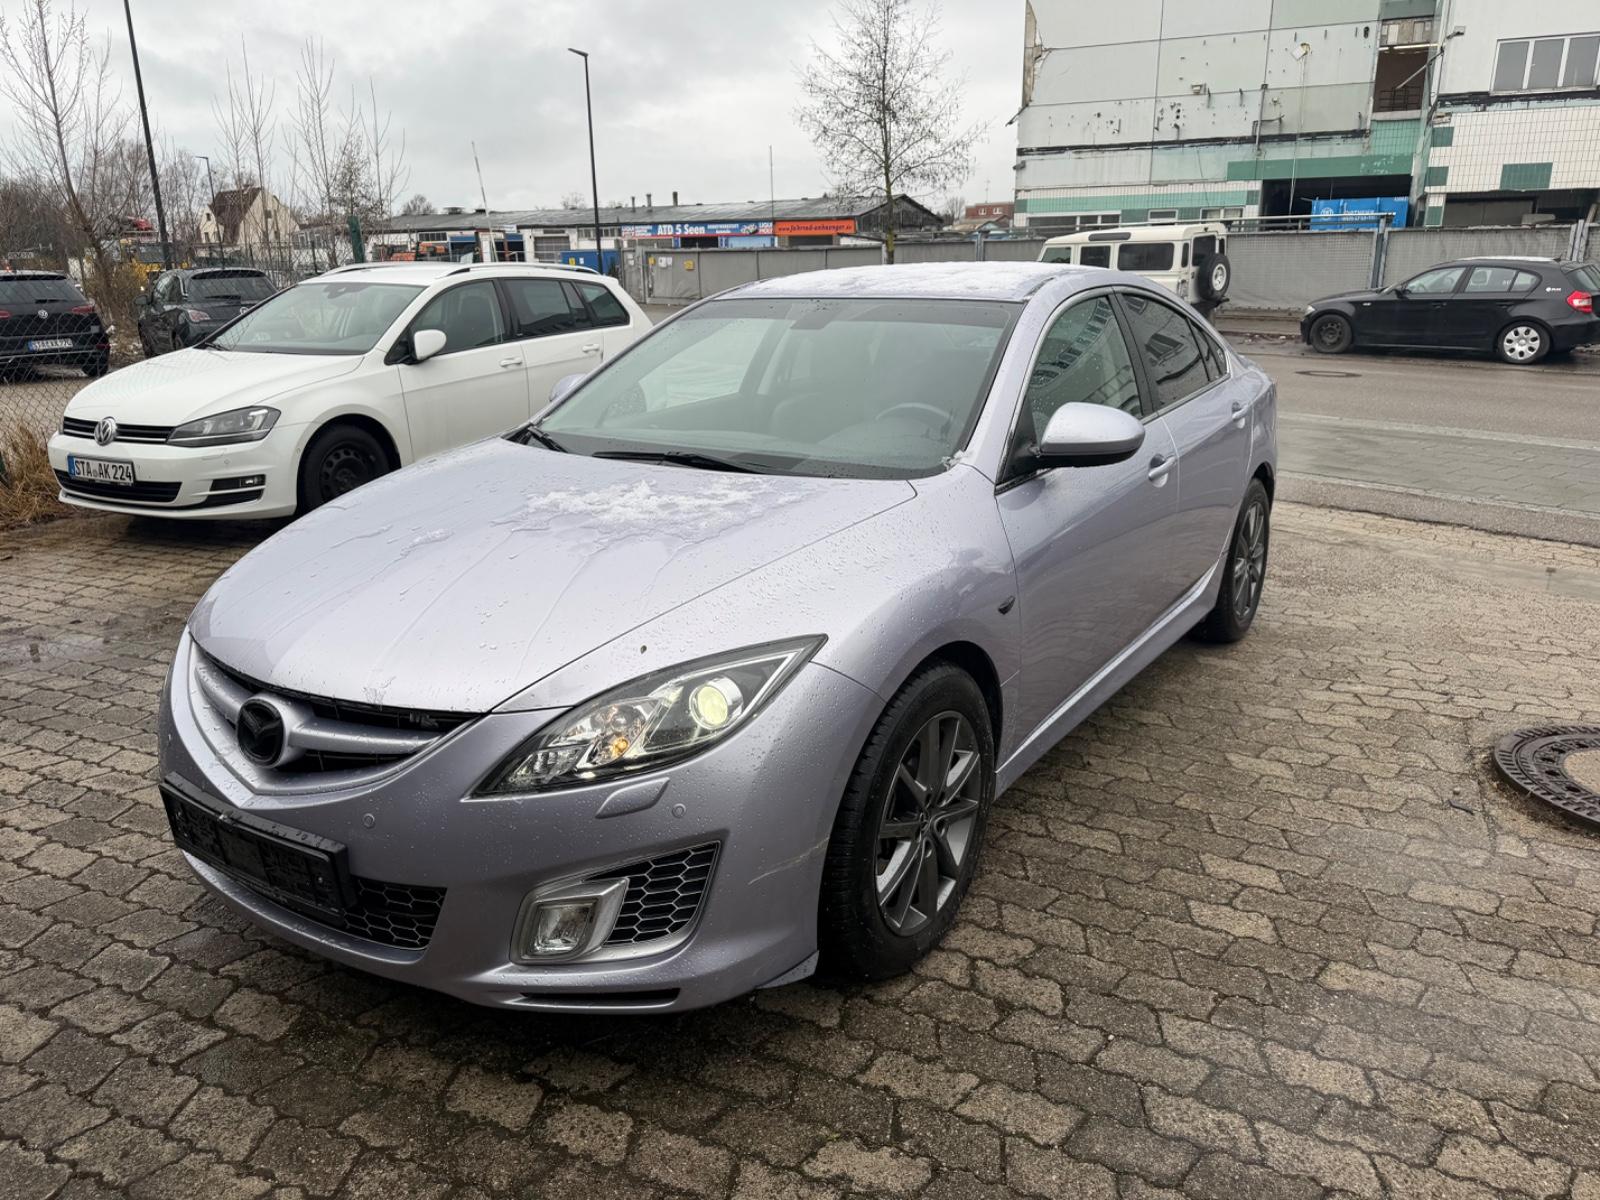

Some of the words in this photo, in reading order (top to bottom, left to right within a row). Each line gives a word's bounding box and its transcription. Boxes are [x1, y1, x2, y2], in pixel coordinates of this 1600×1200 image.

[657, 224, 674, 235] ATD
[675, 224, 682, 235] 5
[684, 224, 706, 234] Seen
[75, 460, 93, 477] STA
[98, 463, 111, 479] AK
[112, 465, 132, 481] 224
